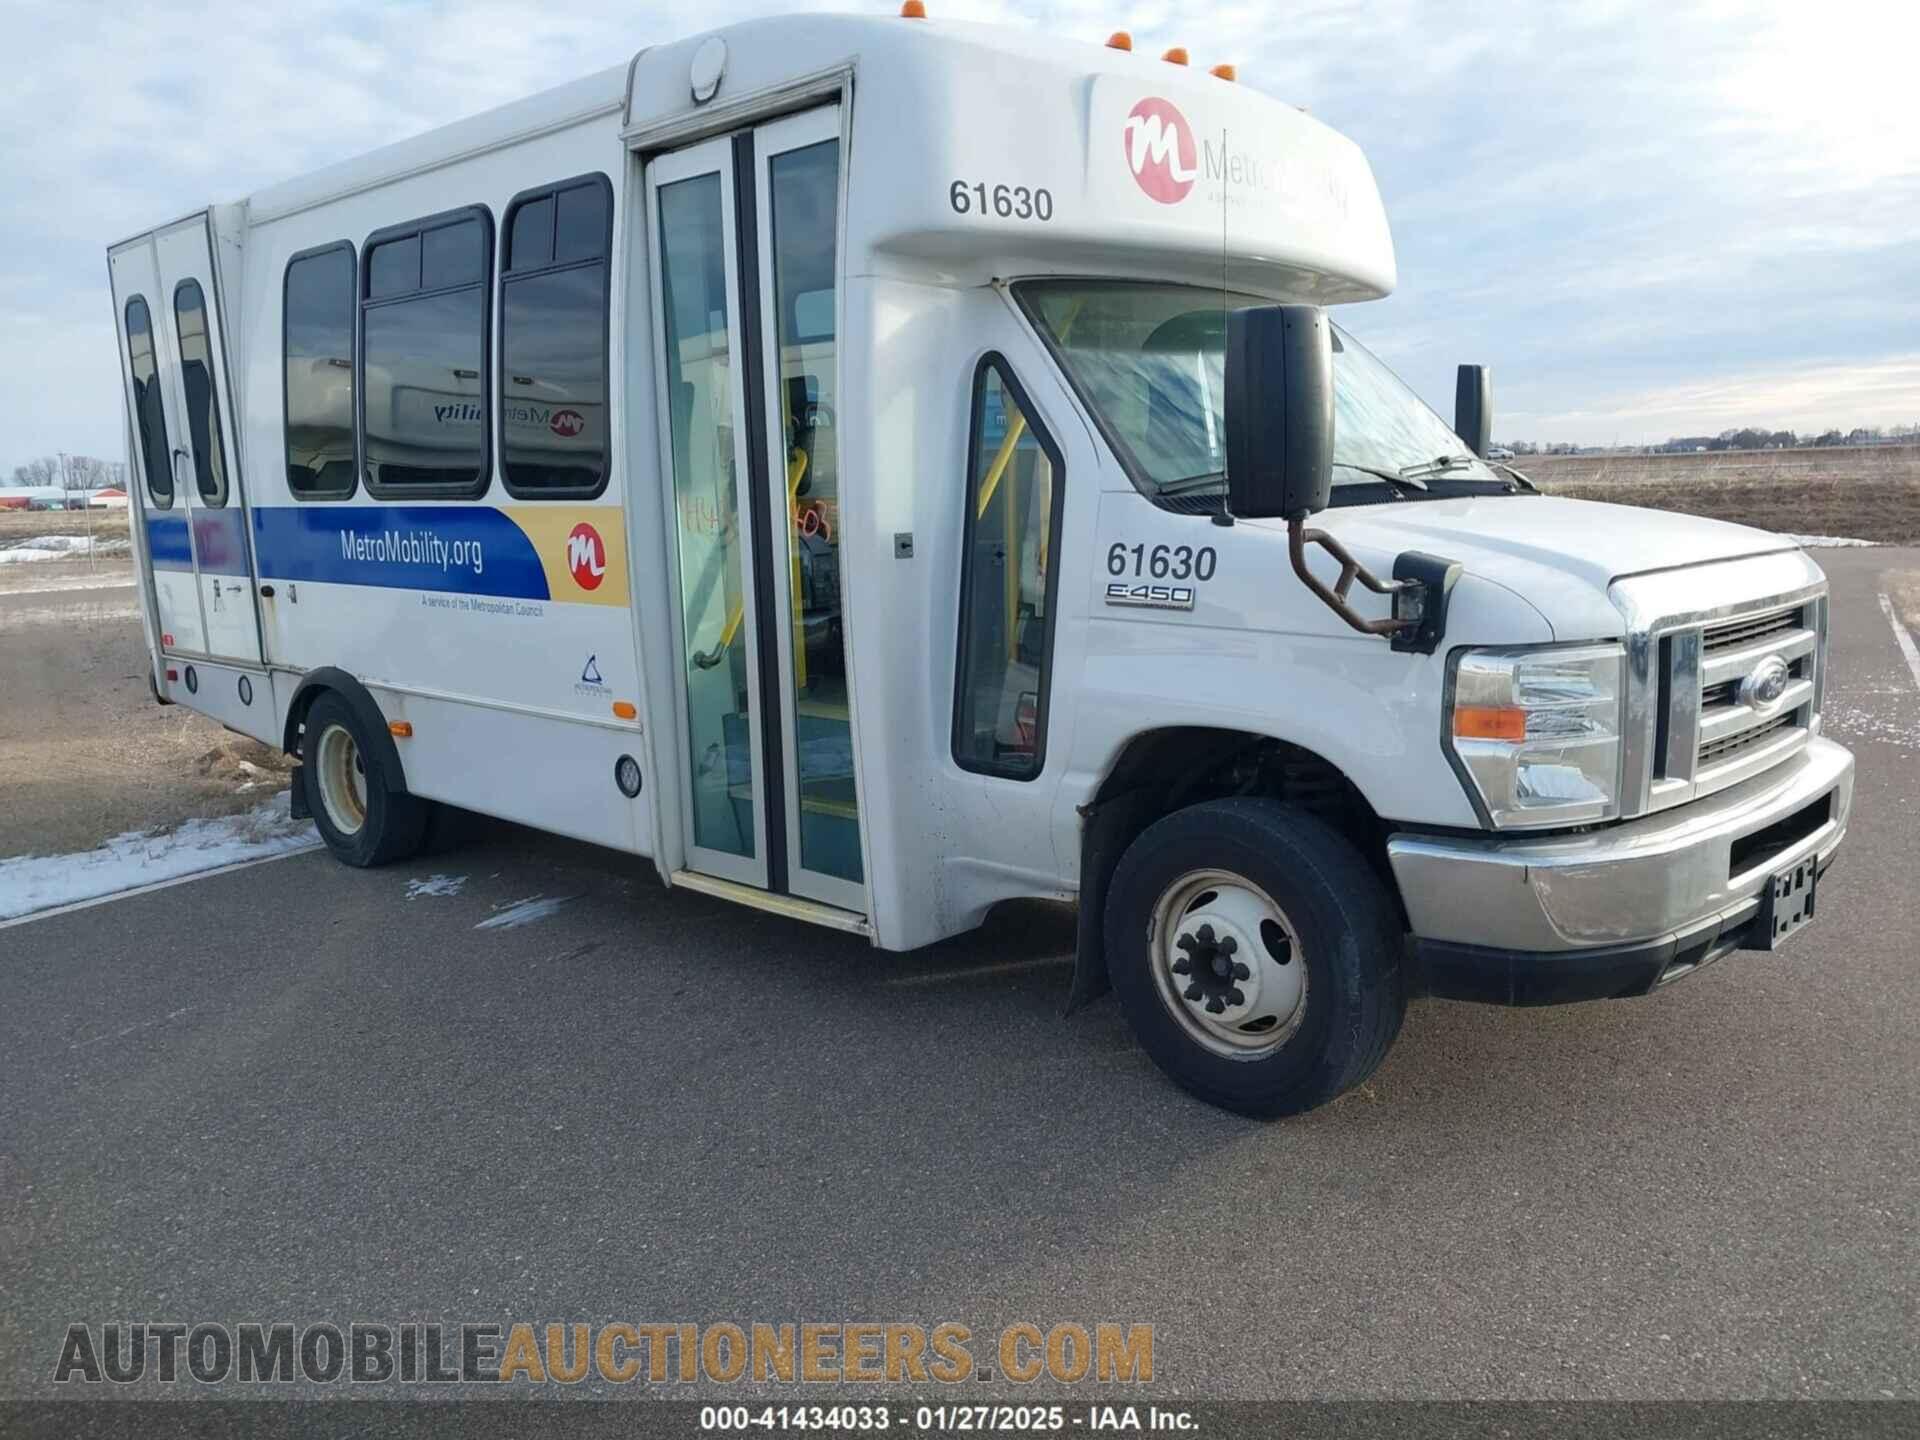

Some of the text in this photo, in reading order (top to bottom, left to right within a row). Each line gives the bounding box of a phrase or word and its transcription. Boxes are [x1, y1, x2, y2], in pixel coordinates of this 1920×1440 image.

[949, 179, 1054, 222] 61630
[340, 529, 483, 574] MetroMobility.org
[1106, 541, 1218, 582] 61630
[428, 595, 450, 608] service
[470, 598, 514, 616] Metropolitan
[515, 602, 544, 617] Council
